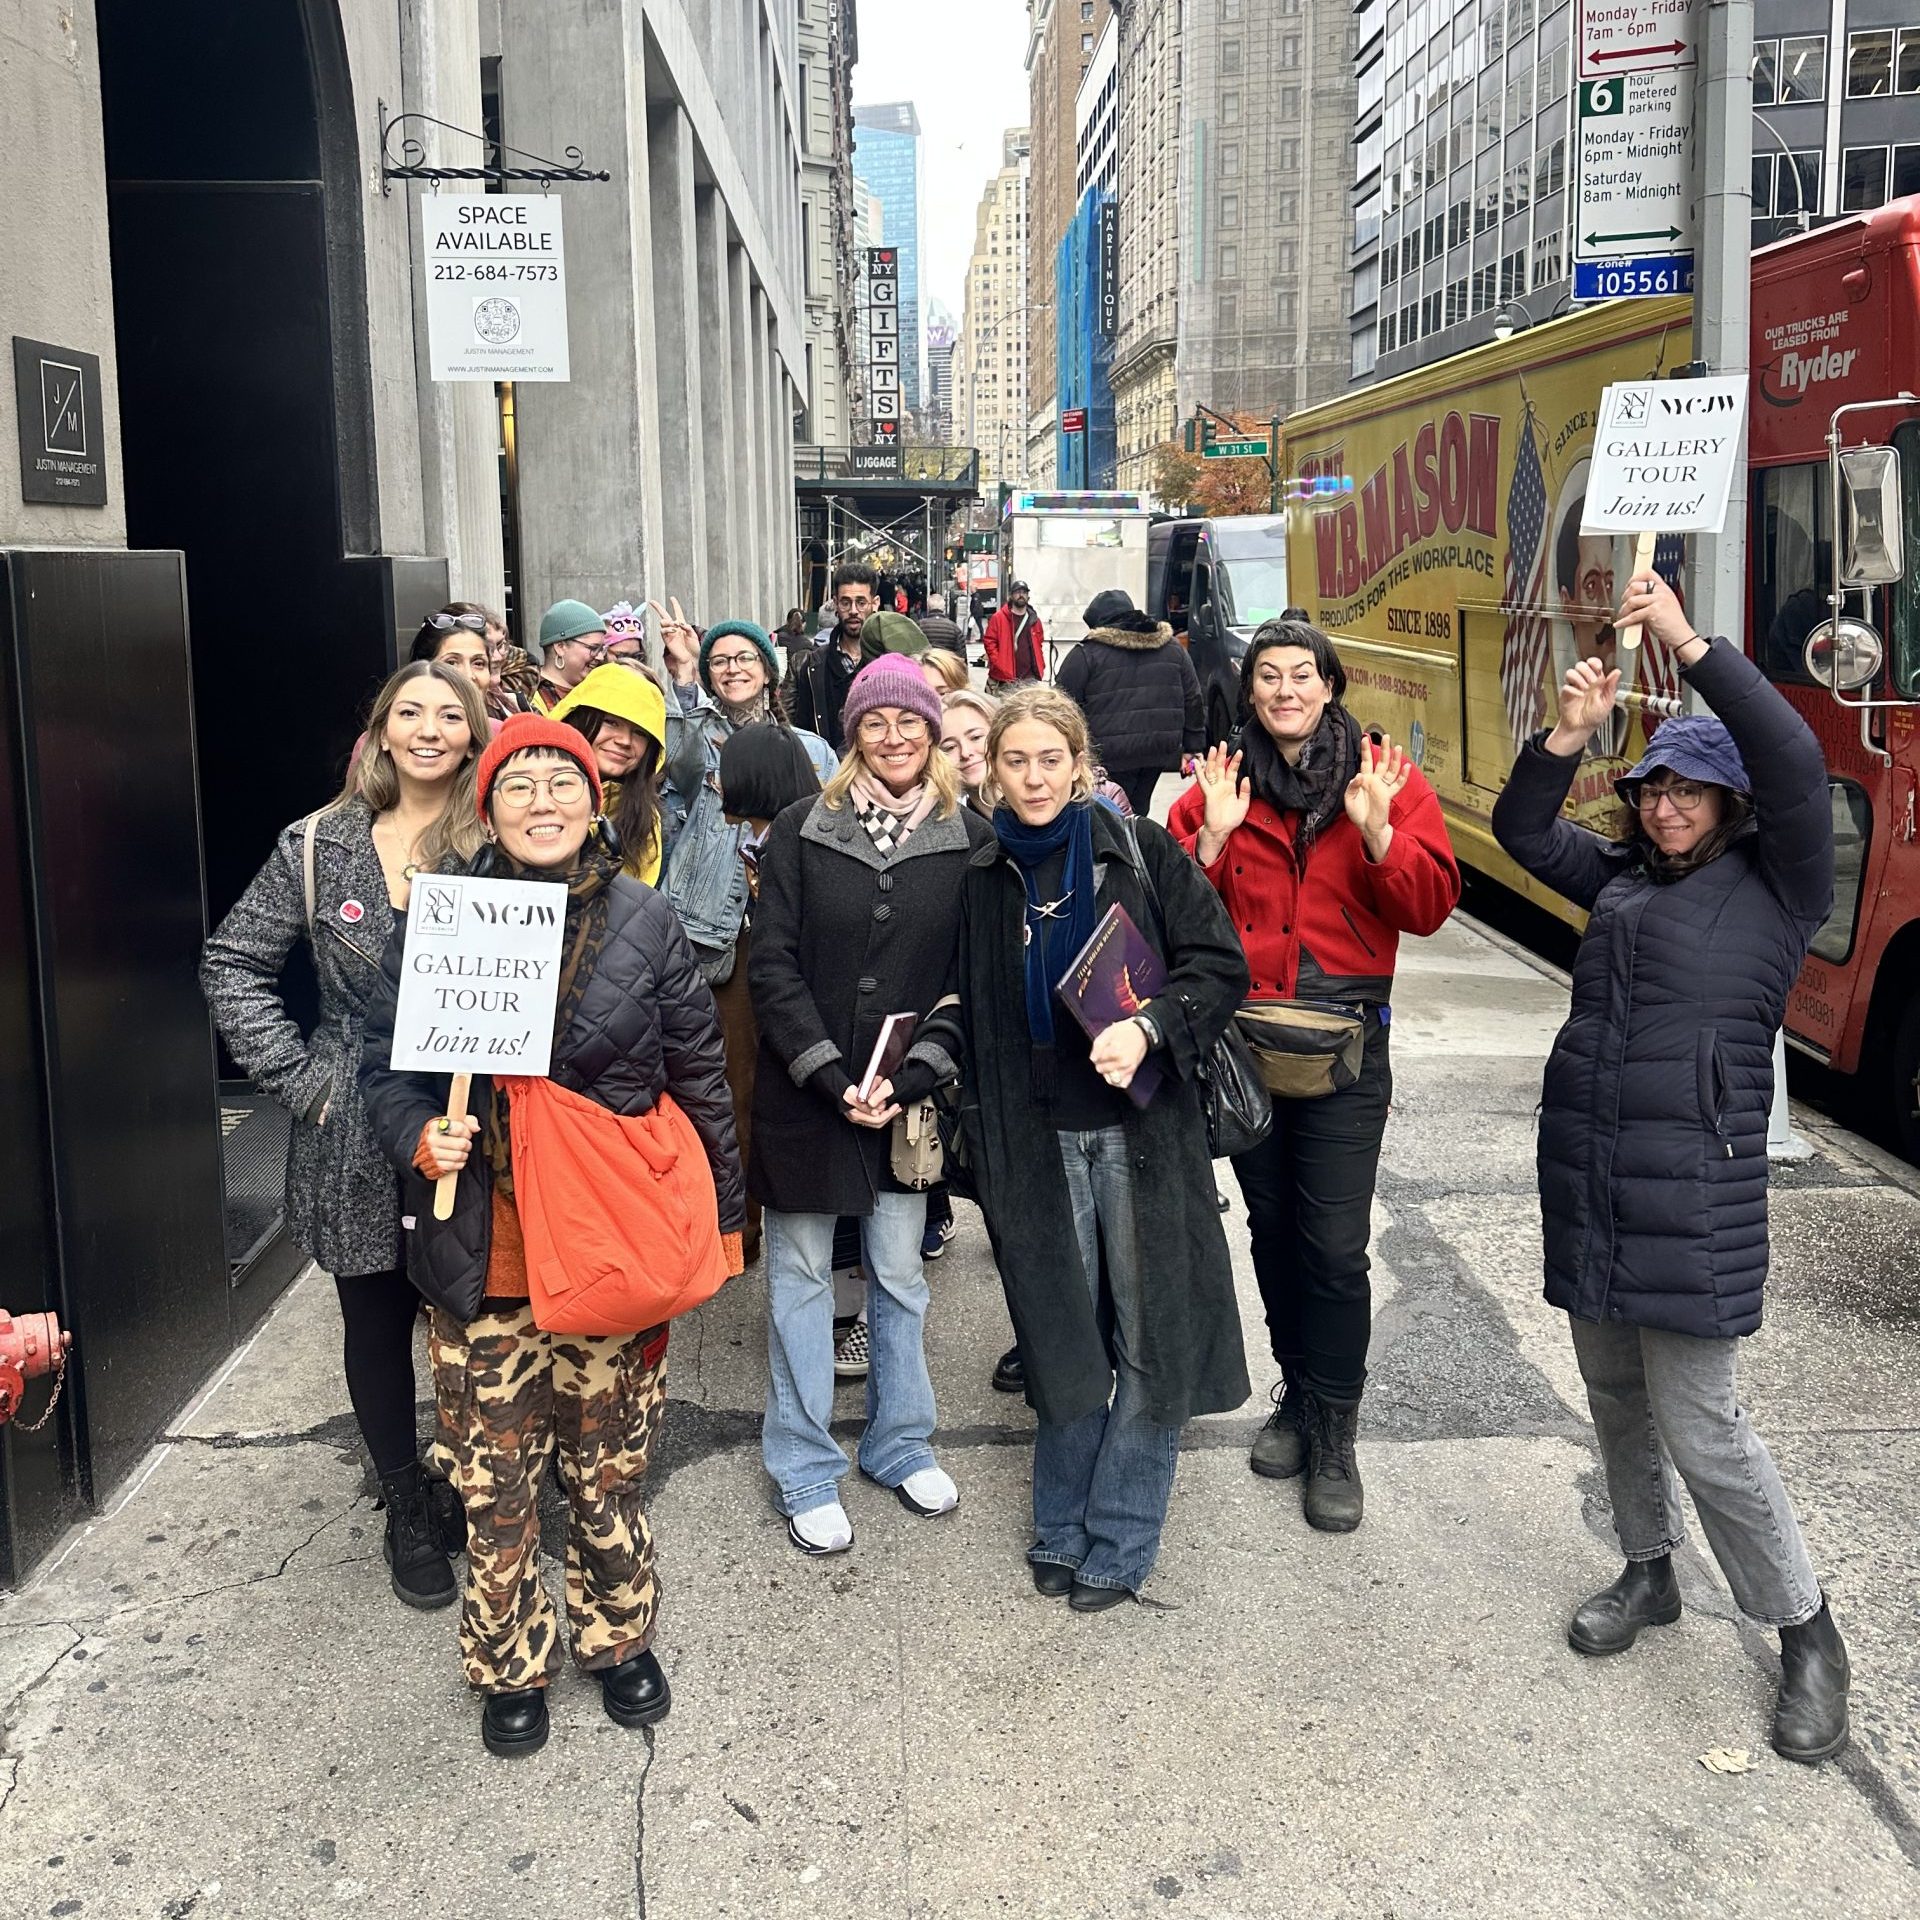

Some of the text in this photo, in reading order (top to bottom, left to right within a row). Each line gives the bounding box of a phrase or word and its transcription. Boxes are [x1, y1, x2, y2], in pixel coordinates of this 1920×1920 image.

[1586, 7, 1637, 23] Monday
[1652, 0, 1692, 15] Friday
[1587, 28, 1613, 40] 7am
[1627, 22, 1657, 37] 6pm
[1629, 76, 1655, 86] hour
[1590, 79, 1613, 113] 6
[1629, 85, 1677, 100] metered
[1629, 101, 1671, 116] parking
[1585, 130, 1635, 146] Monday
[1649, 125, 1689, 140] Friday
[1585, 149, 1613, 164] 6pm
[1627, 141, 1683, 159] Midnight
[1585, 170, 1642, 186] Saturday
[1584, 190, 1612, 203] 8am
[1626, 182, 1681, 200] Midnight
[458, 206, 527, 224] SPACE
[435, 232, 553, 250] AVAILABLE
[434, 265, 558, 281] 212-684-7573
[872, 264, 895, 275] NY
[1104, 209, 1115, 329] MARTINIQUE
[1597, 269, 1678, 295] 105561
[1765, 310, 1849, 340] OUR TRUCKS ARE
[873, 282, 894, 414] GIFTS
[1772, 325, 1840, 351] LEASED FROM
[1780, 345, 1856, 393] Ryder
[874, 434, 897, 445] NY
[1554, 411, 1588, 455] SINCE
[1218, 444, 1253, 455] W 31 St
[1606, 437, 1727, 457] GALLERY
[36, 458, 97, 475] JUSTIN MANAGEMENT
[856, 456, 897, 468] LUGGAGE
[1623, 465, 1697, 484] TOUR
[1603, 493, 1705, 516] Join us!
[1320, 545, 1495, 628] PRODUCTS FOR THE WORKPLACE
[1388, 608, 1451, 639] SINCE 1898
[413, 953, 550, 980] GALLERY
[434, 988, 520, 1013] TOUR
[1795, 991, 1834, 1028] 348981
[416, 1026, 531, 1056] Join us!
